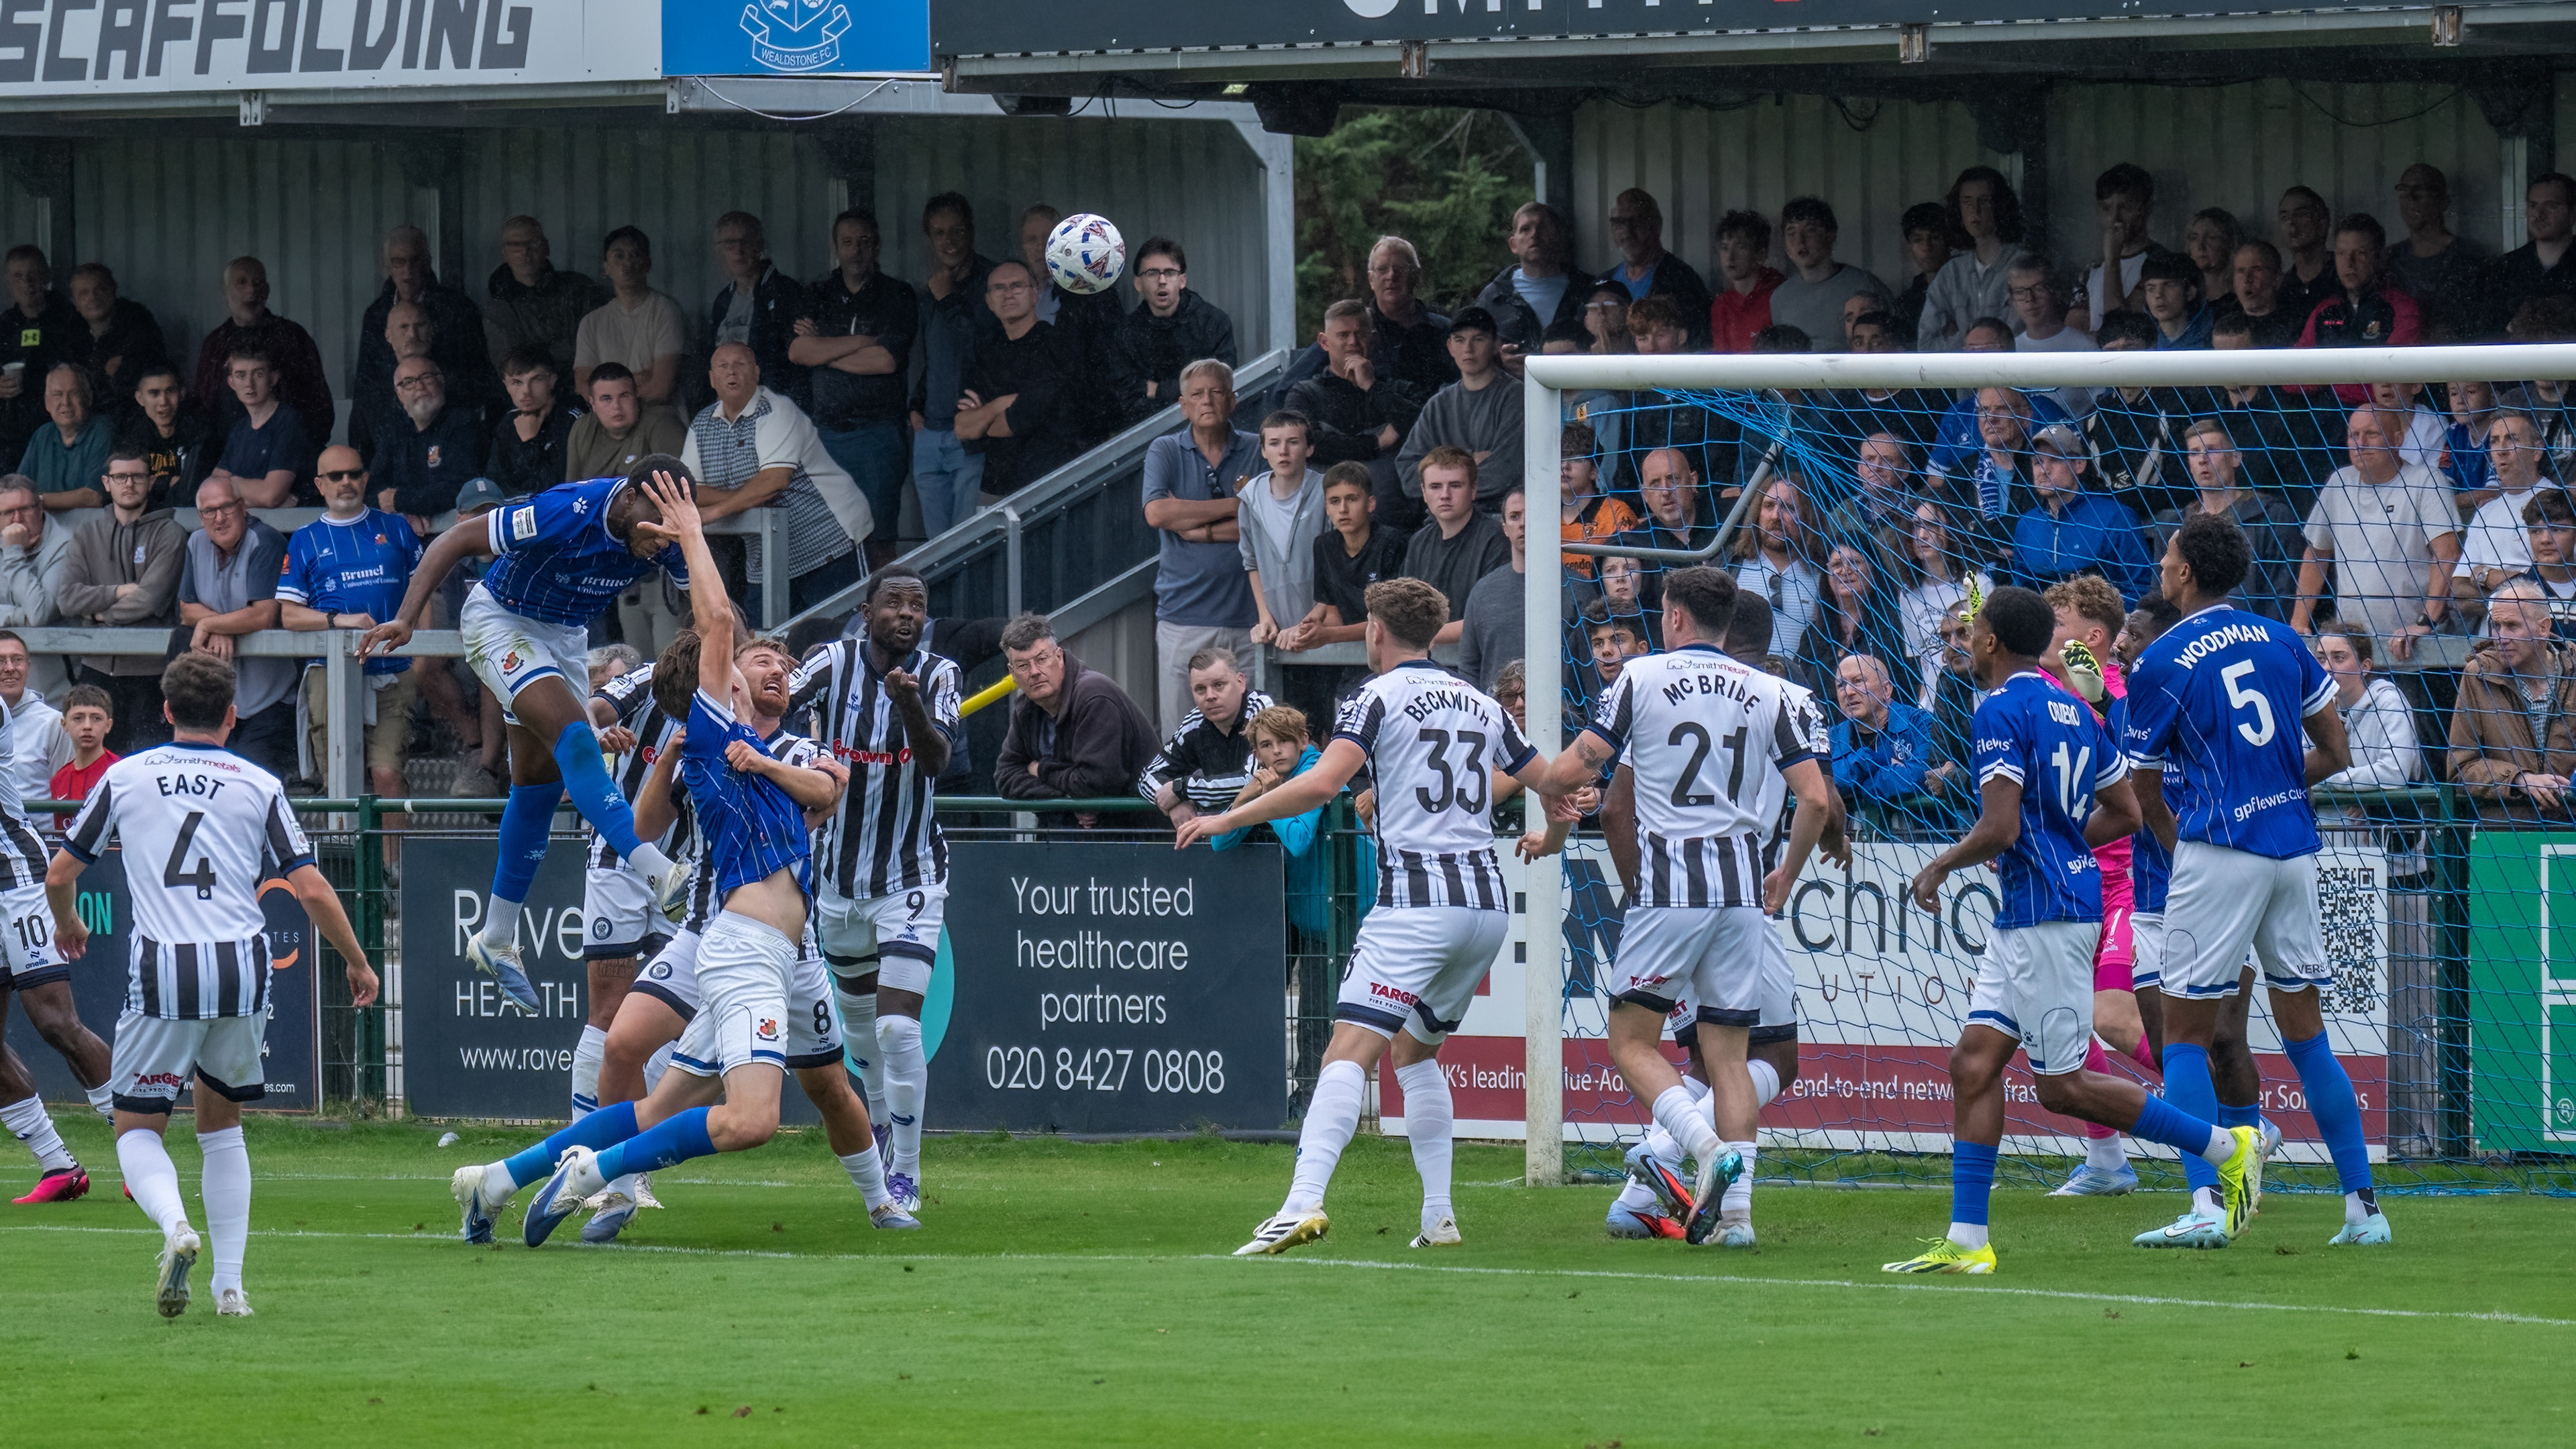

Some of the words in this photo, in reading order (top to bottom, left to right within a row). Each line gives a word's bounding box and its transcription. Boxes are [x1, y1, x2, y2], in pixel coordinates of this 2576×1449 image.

[0, 0, 533, 83] SCAFFOLDING
[761, 48, 818, 66] WEALDSTONE
[819, 46, 831, 61] FC
[2174, 623, 2271, 670] WOODMAN
[1404, 690, 1489, 727] BECKWITH
[1698, 674, 1761, 715] BRIDE
[2220, 658, 2275, 747] 5
[833, 738, 893, 765] Crown
[1668, 721, 1748, 808] 21
[156, 774, 225, 800] EAST
[1415, 728, 1487, 816] 33
[164, 811, 217, 900] 4
[906, 890, 925, 922] 9
[1010, 876, 1079, 916] Your
[1088, 876, 1194, 917] trusted
[13, 914, 48, 951] 10
[2110, 907, 2124, 936] 1
[1017, 929, 1189, 971] healthcare
[1041, 984, 1167, 1031] partners
[1370, 981, 1419, 1006] TARGE
[813, 1000, 832, 1035] 8
[460, 1047, 574, 1072] www.rave
[987, 1046, 1045, 1090] 020
[1055, 1047, 1133, 1091] 8427
[1144, 1049, 1225, 1094] 0808
[1472, 1064, 1526, 1089] leadin
[1792, 1073, 1898, 1101] end-to-end
